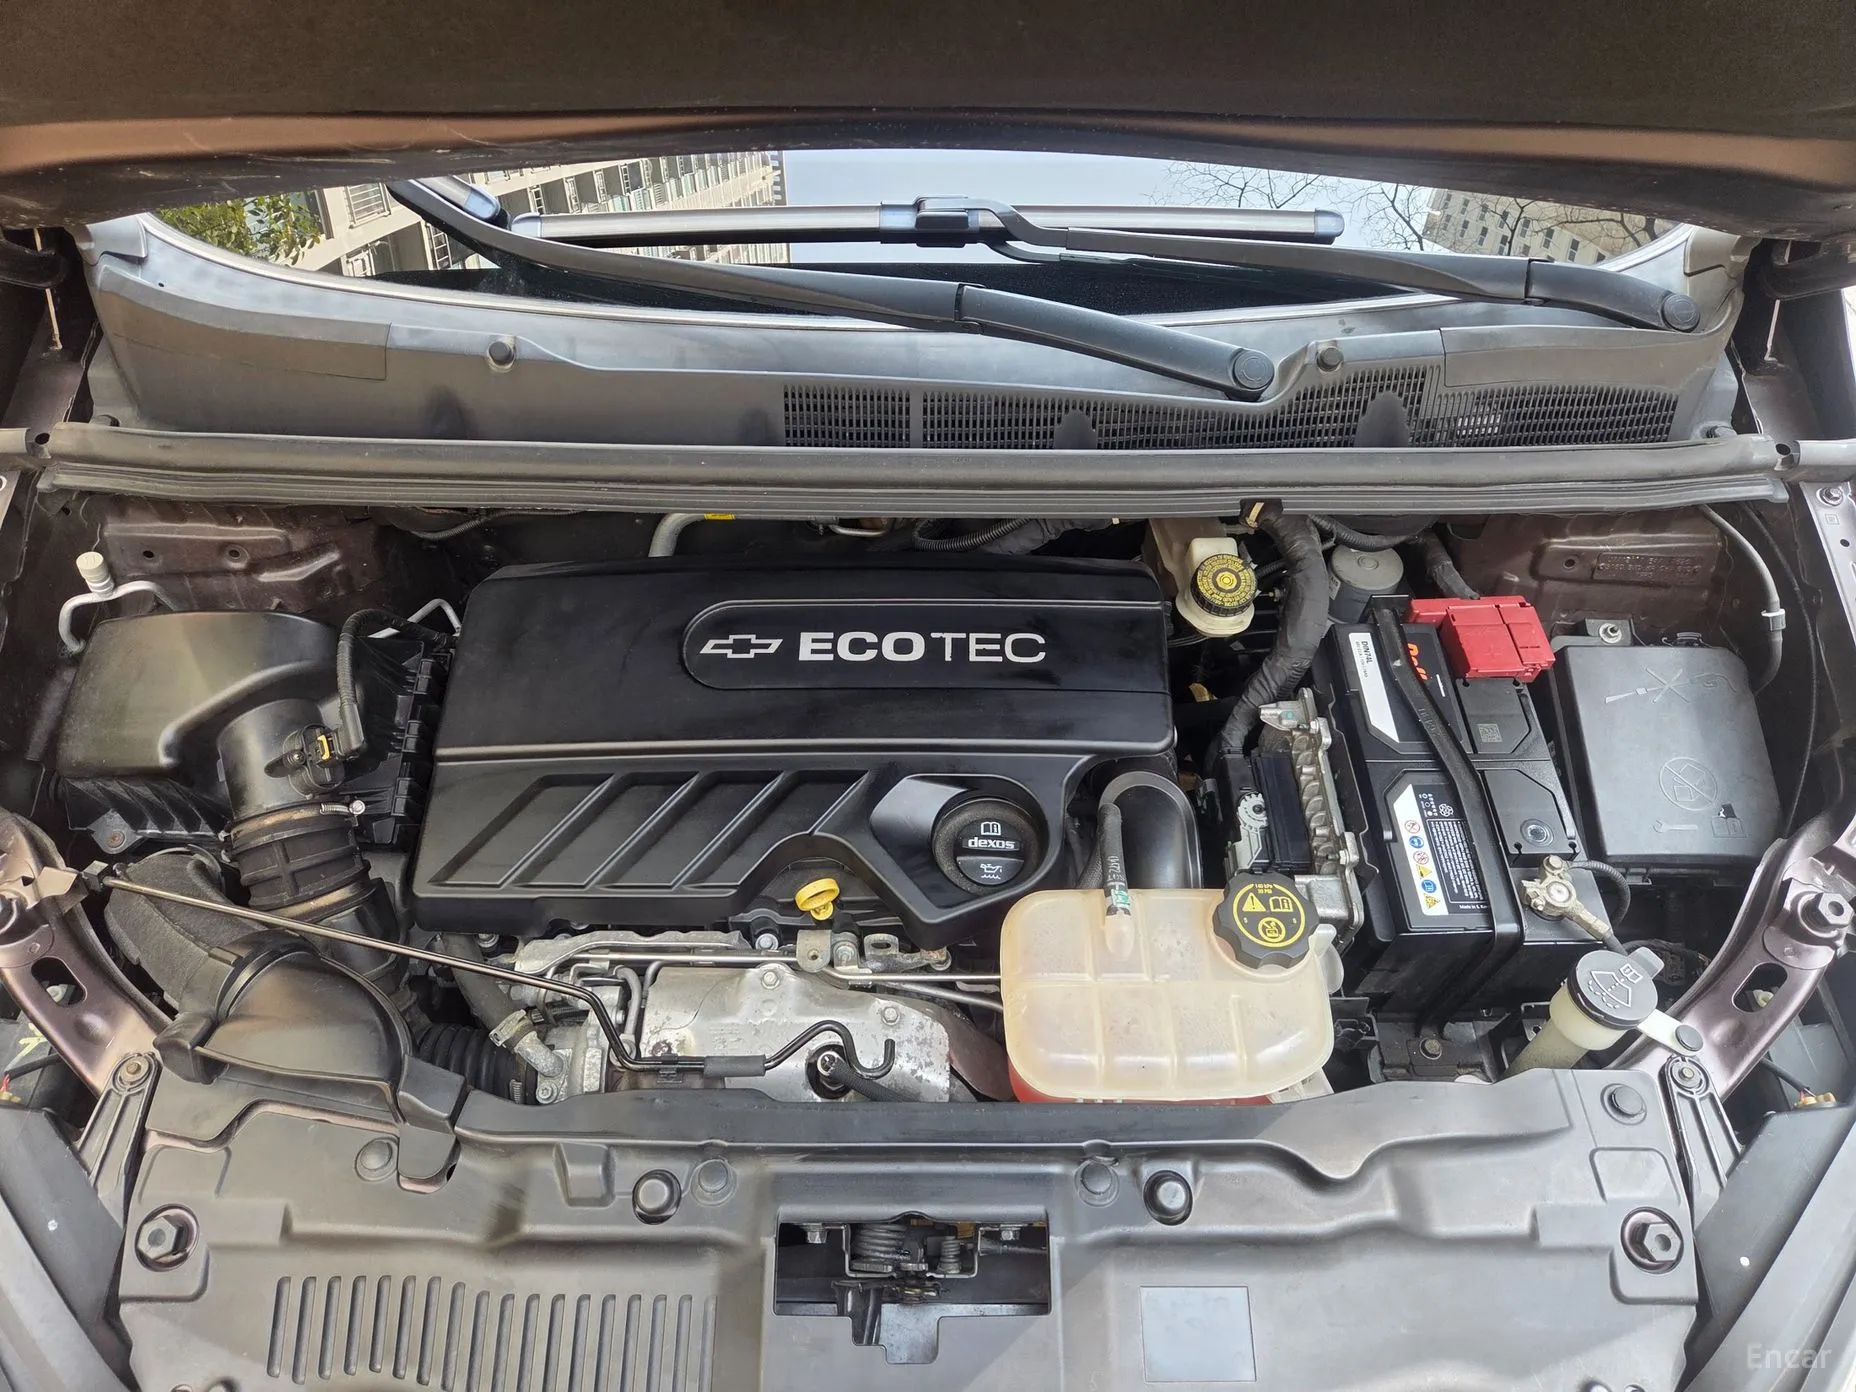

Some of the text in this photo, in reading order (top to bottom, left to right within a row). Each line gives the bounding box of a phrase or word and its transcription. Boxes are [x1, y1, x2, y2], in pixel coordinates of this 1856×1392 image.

[799, 631, 1046, 663] ECOTEC
[1361, 641, 1373, 664] DIN74L
[968, 836, 1016, 850] dexos
